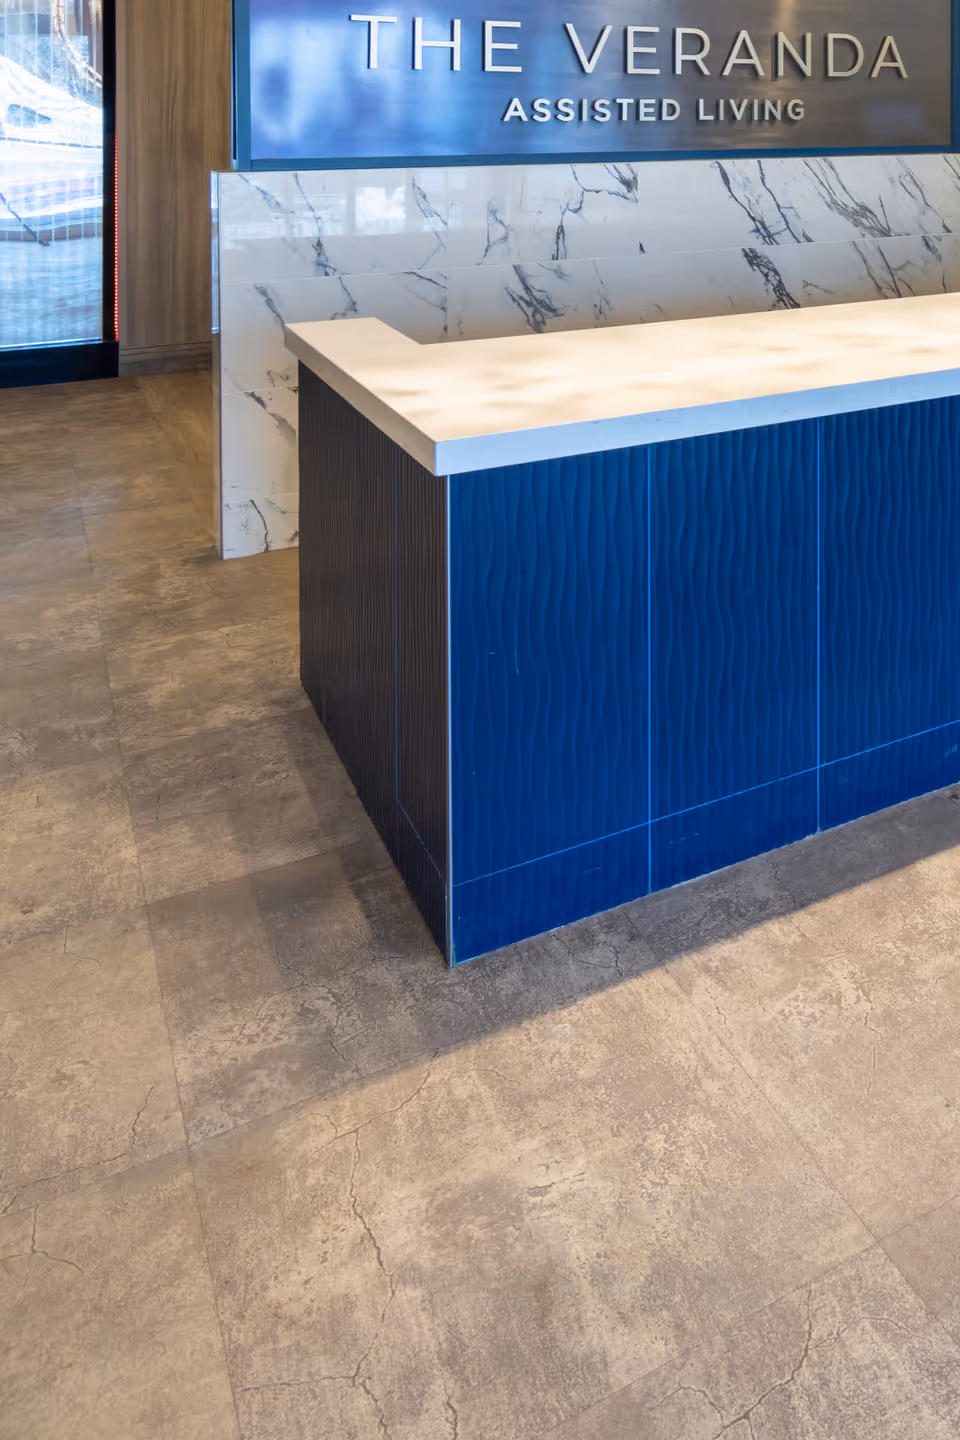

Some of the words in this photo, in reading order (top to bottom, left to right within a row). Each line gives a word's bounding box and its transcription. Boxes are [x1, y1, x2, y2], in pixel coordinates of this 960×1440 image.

[349, 14, 523, 73] THE
[563, 22, 908, 79] VERANDA
[502, 97, 681, 123] ASSISTED
[698, 98, 806, 122] LIVING
